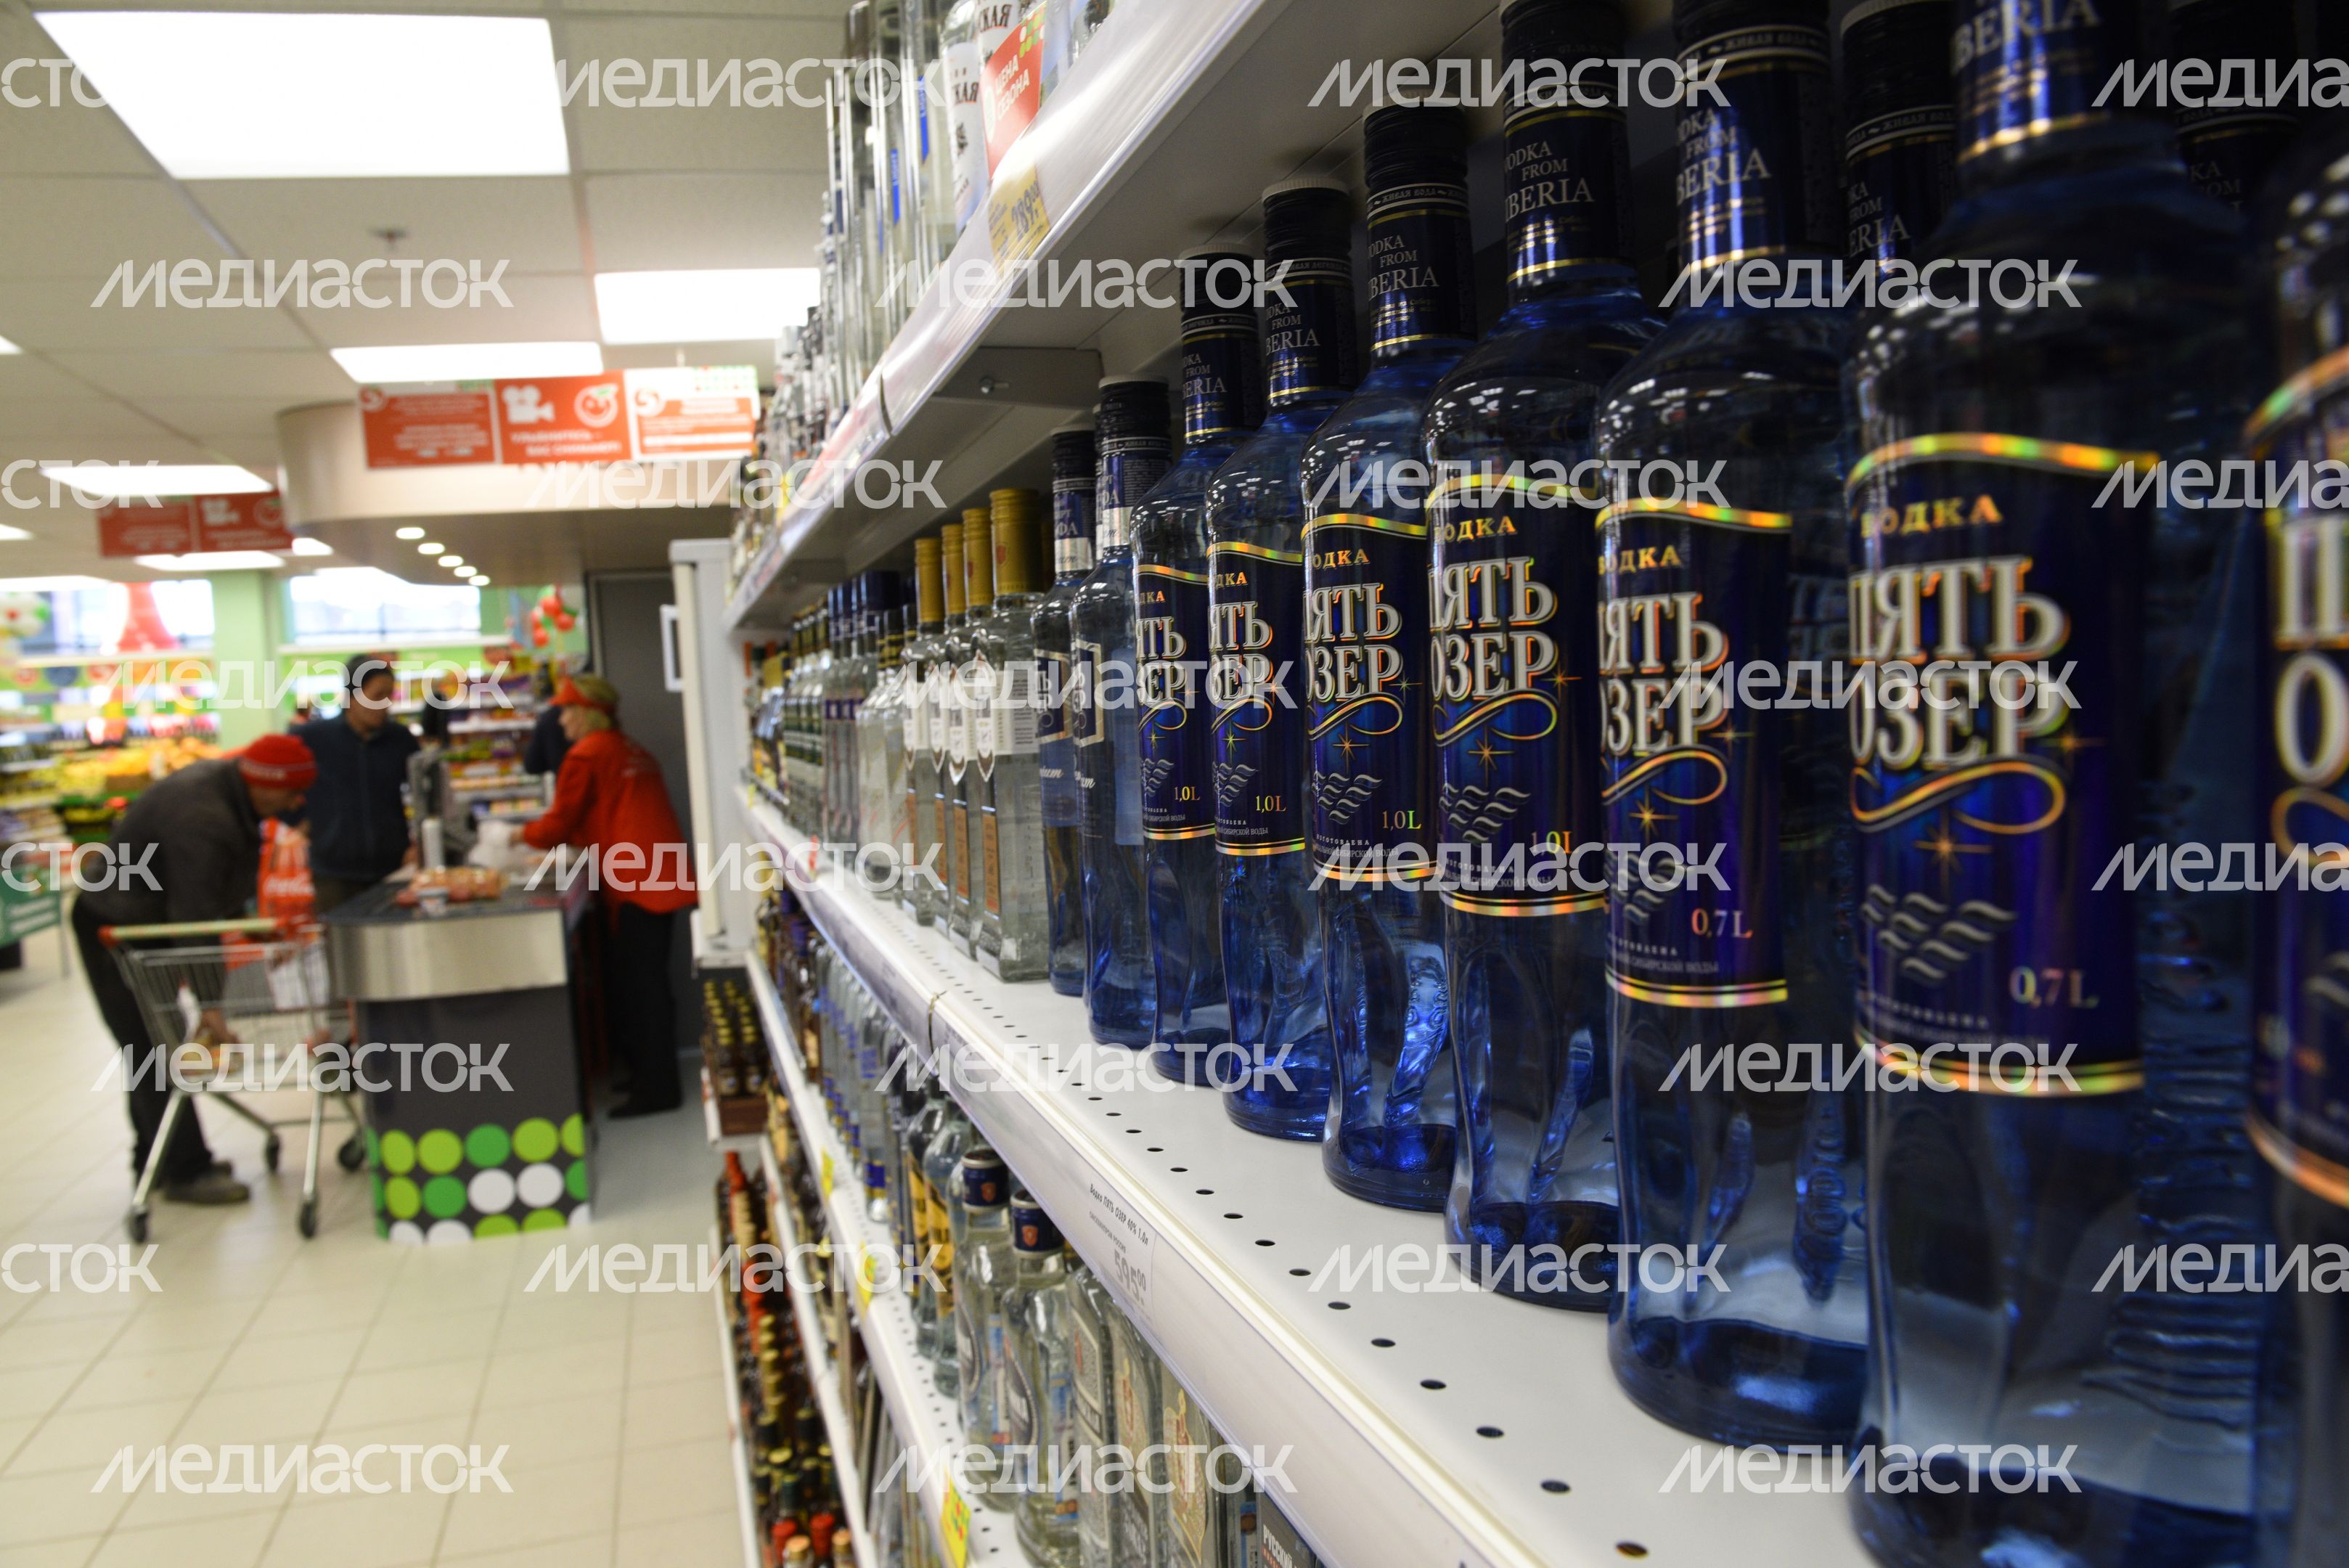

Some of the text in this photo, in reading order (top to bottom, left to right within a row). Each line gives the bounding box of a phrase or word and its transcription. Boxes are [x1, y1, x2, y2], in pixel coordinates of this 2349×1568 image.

[995, 54, 1018, 95] ЦЕНА
[1685, 126, 1736, 160] FROM
[1521, 158, 1568, 181] FROM
[1676, 147, 1771, 206] BERIA
[1505, 178, 1595, 222] IBERIA
[1380, 250, 1418, 268] FROM
[1368, 266, 1440, 301] BERIA
[1272, 314, 1301, 330] FROM
[1266, 328, 1320, 356] BERIA
[1185, 364, 1211, 377] FROM
[1312, 548, 1371, 570] ОДКА
[1140, 590, 1166, 603] ДКА
[1215, 571, 1249, 589] ДКА
[1208, 600, 1273, 651] ЯТЬ
[1849, 554, 2072, 666] ПЯТЬ
[1136, 616, 1188, 660] ЯТЬ
[1210, 653, 1274, 703] ЗЕР
[1430, 630, 1558, 702] ОЗЕР
[1137, 661, 1188, 706] ЗЕР
[1850, 659, 2072, 772] ОЗЕР
[1173, 786, 1200, 802] 1,0L
[1255, 795, 1287, 813] 1,0L
[1381, 809, 1423, 831] 1,0L
[1103, 1195, 1114, 1214] ПЯТЬ
[1115, 1206, 1127, 1225] ОЗЕР
[1127, 1218, 1137, 1236] 40%
